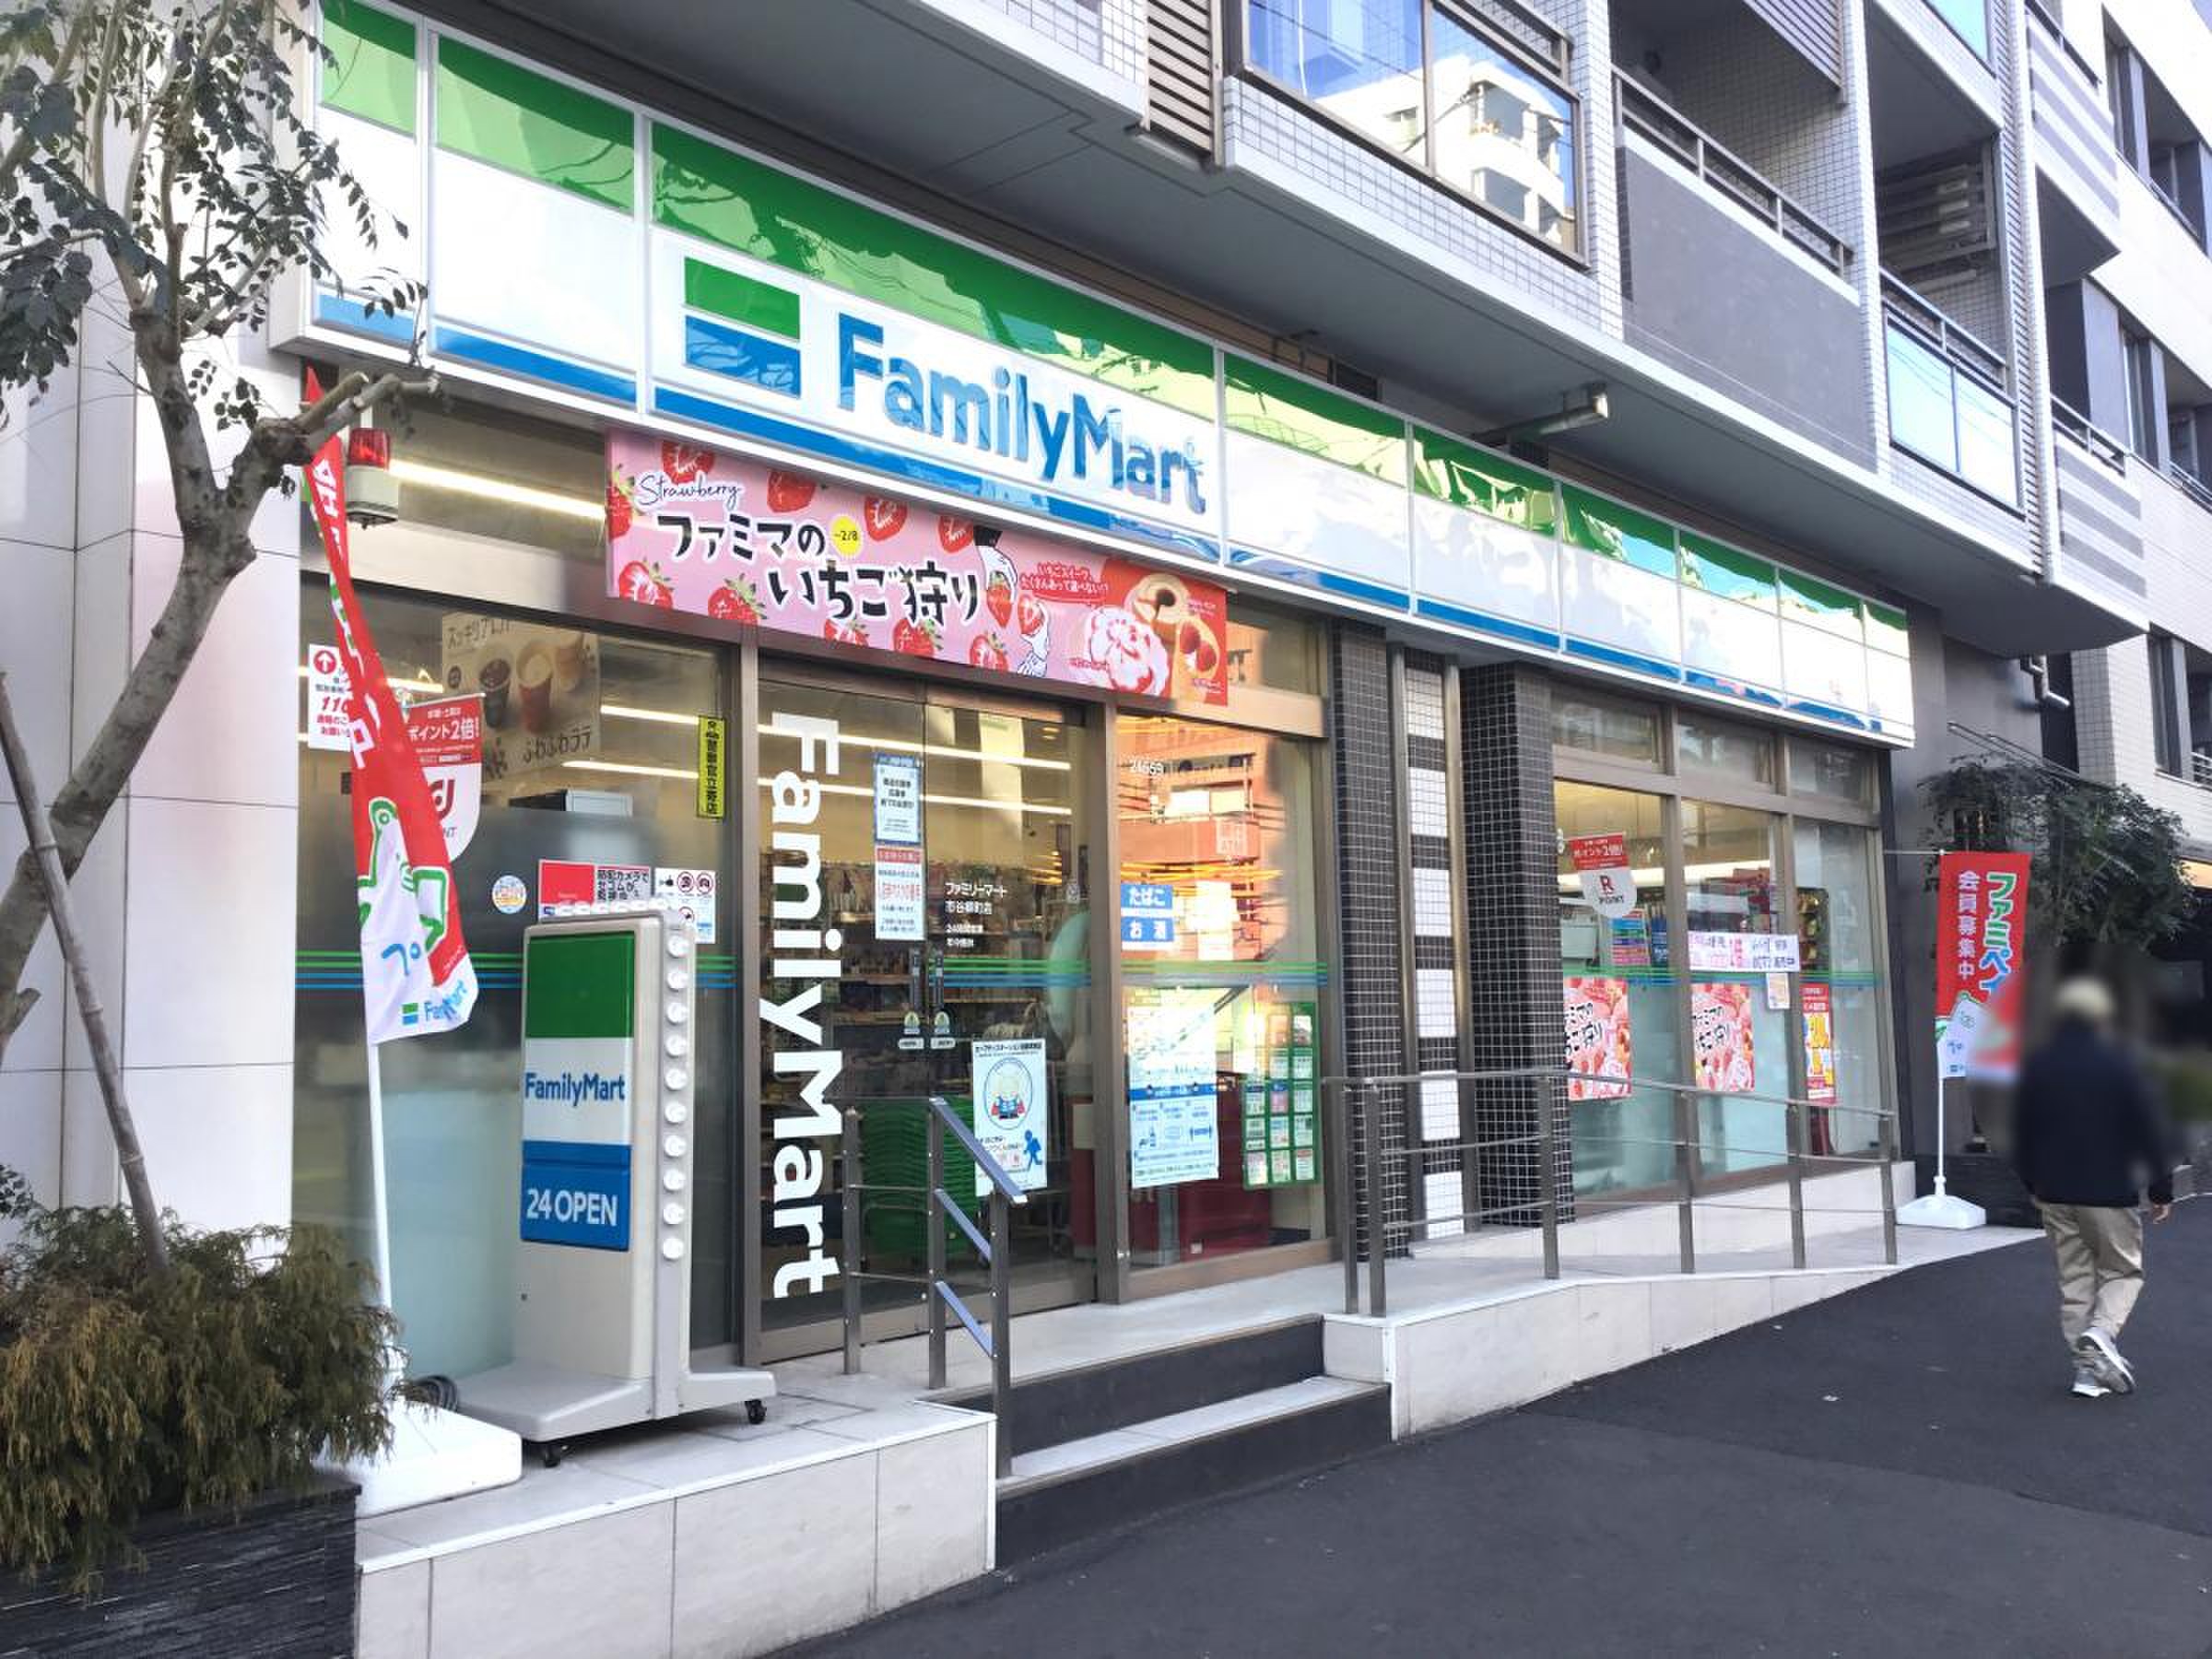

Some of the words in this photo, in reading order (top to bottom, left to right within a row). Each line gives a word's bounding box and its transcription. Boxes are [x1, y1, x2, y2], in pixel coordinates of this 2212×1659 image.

[836, 312, 1206, 515] FamilyMart
[639, 474, 739, 510] Strawberry
[657, 513, 826, 560] ファミマの
[769, 559, 978, 627] いちご狩り
[945, 881, 1008, 899] ファミリーマート
[1128, 886, 1166, 907] たばこ
[1958, 870, 1980, 981] 会員募集中
[759, 712, 842, 1298] FamilyMart
[524, 1072, 625, 1106] FamilyMart
